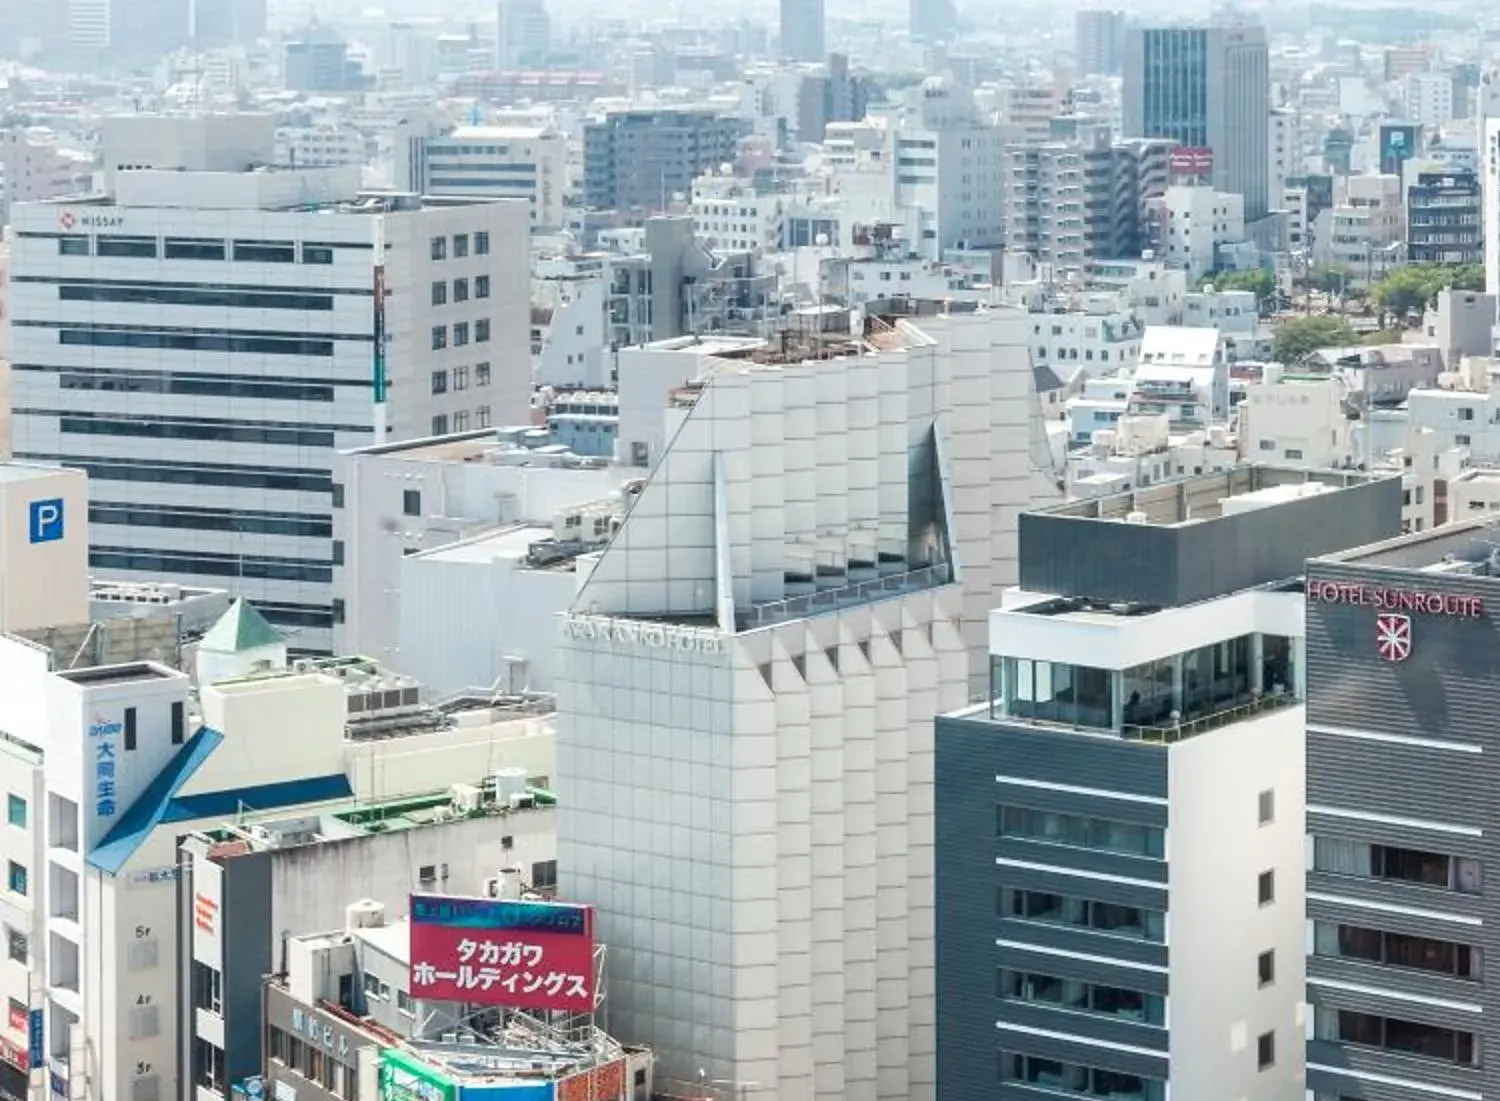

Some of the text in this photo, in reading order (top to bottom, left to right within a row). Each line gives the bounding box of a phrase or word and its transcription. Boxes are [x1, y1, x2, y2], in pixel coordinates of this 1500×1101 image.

[81, 215, 123, 228] NISSAY
[38, 505, 58, 538] P
[1307, 580, 1483, 617] HOTEL SUNROUTE
[96, 741, 116, 817] 大同生命
[135, 925, 152, 938] 5F
[456, 937, 543, 967] タカガワ
[412, 961, 588, 999] ホールディングス
[136, 1062, 152, 1074] 3F
